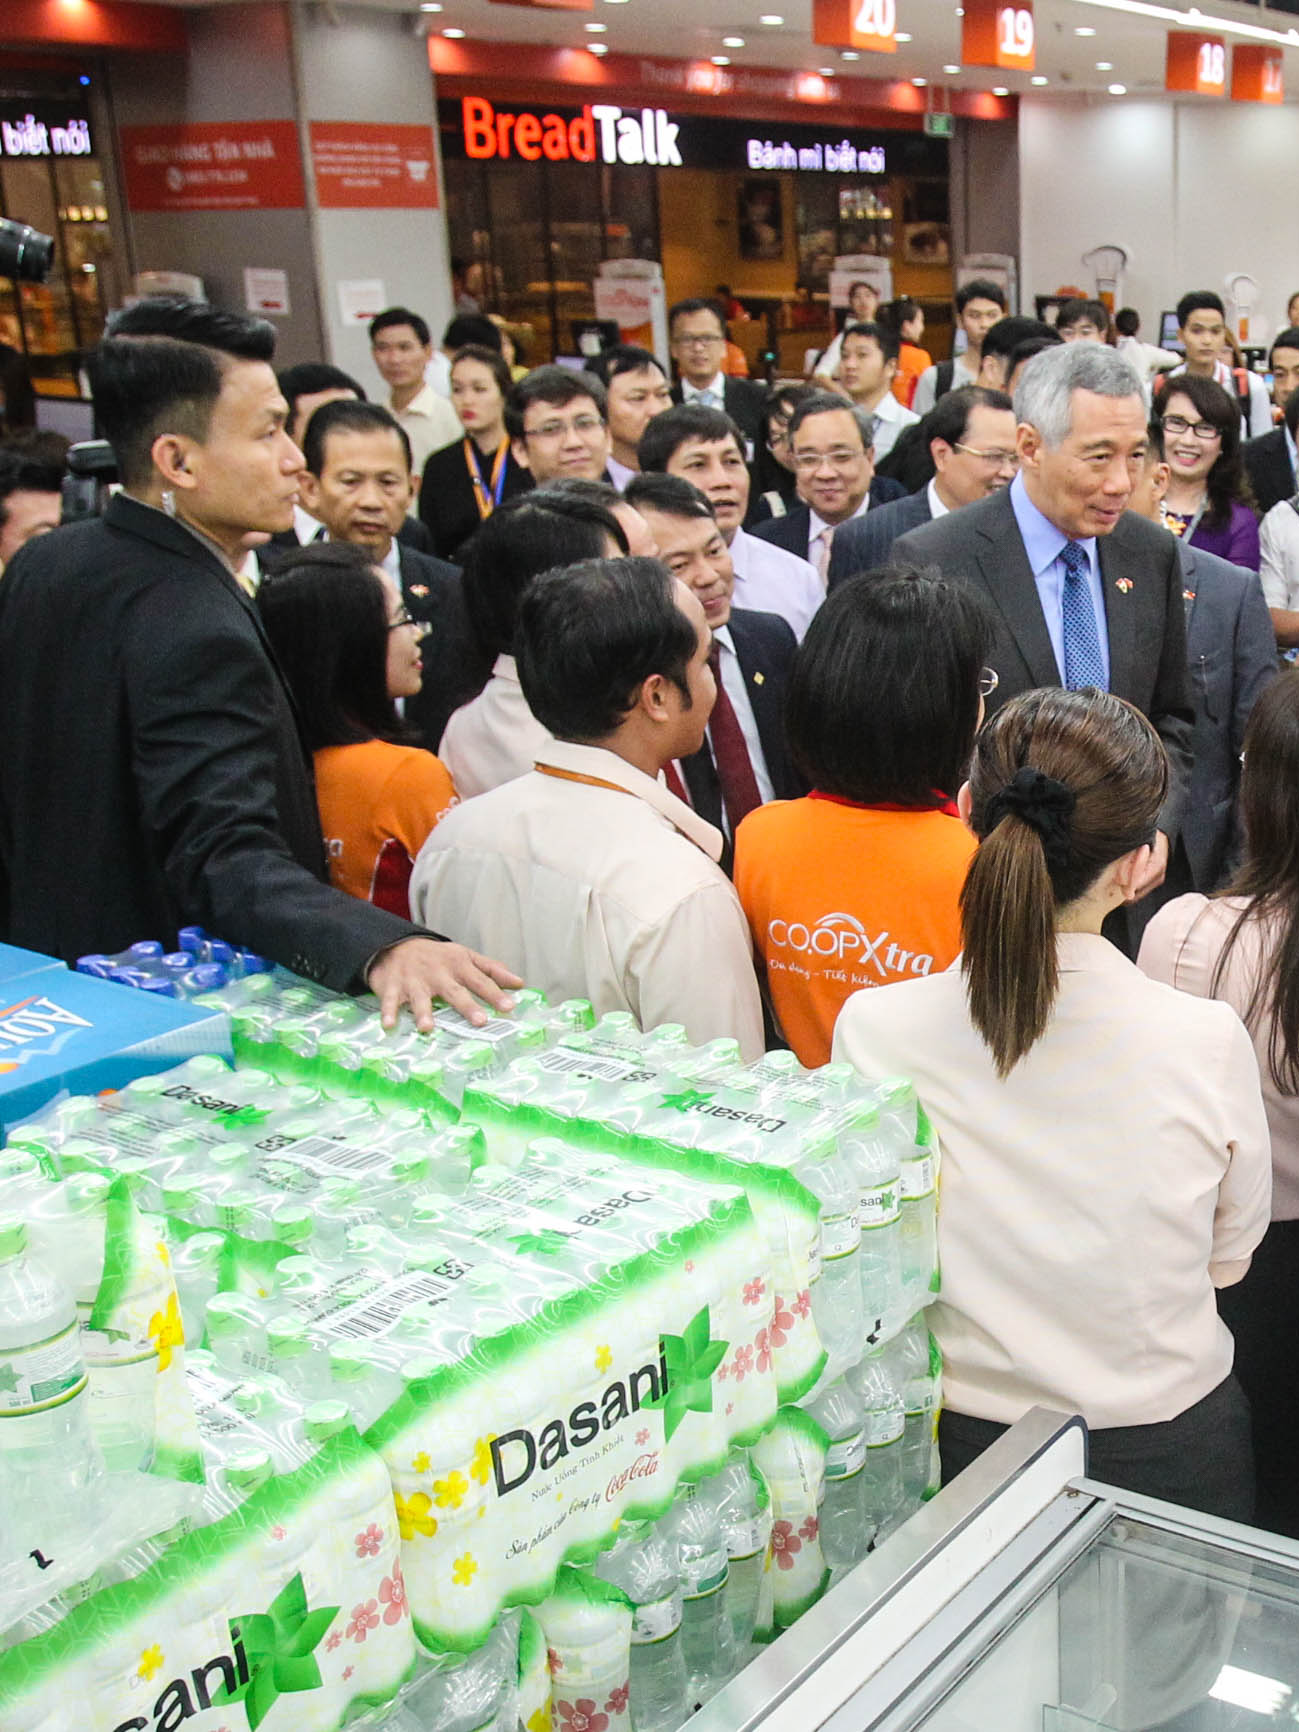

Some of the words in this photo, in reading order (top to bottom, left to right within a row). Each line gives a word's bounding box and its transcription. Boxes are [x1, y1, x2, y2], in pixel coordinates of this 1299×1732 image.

[854, 0, 896, 37] 20
[1001, 7, 1034, 56] 19
[1199, 43, 1225, 84] 18
[50, 119, 92, 155] nói
[461, 96, 684, 167] BreadTalk
[747, 138, 798, 170] Bánh
[858, 146, 886, 174] nói
[160, 1084, 246, 1115] Dasani
[489, 1341, 670, 1498] Dasani
